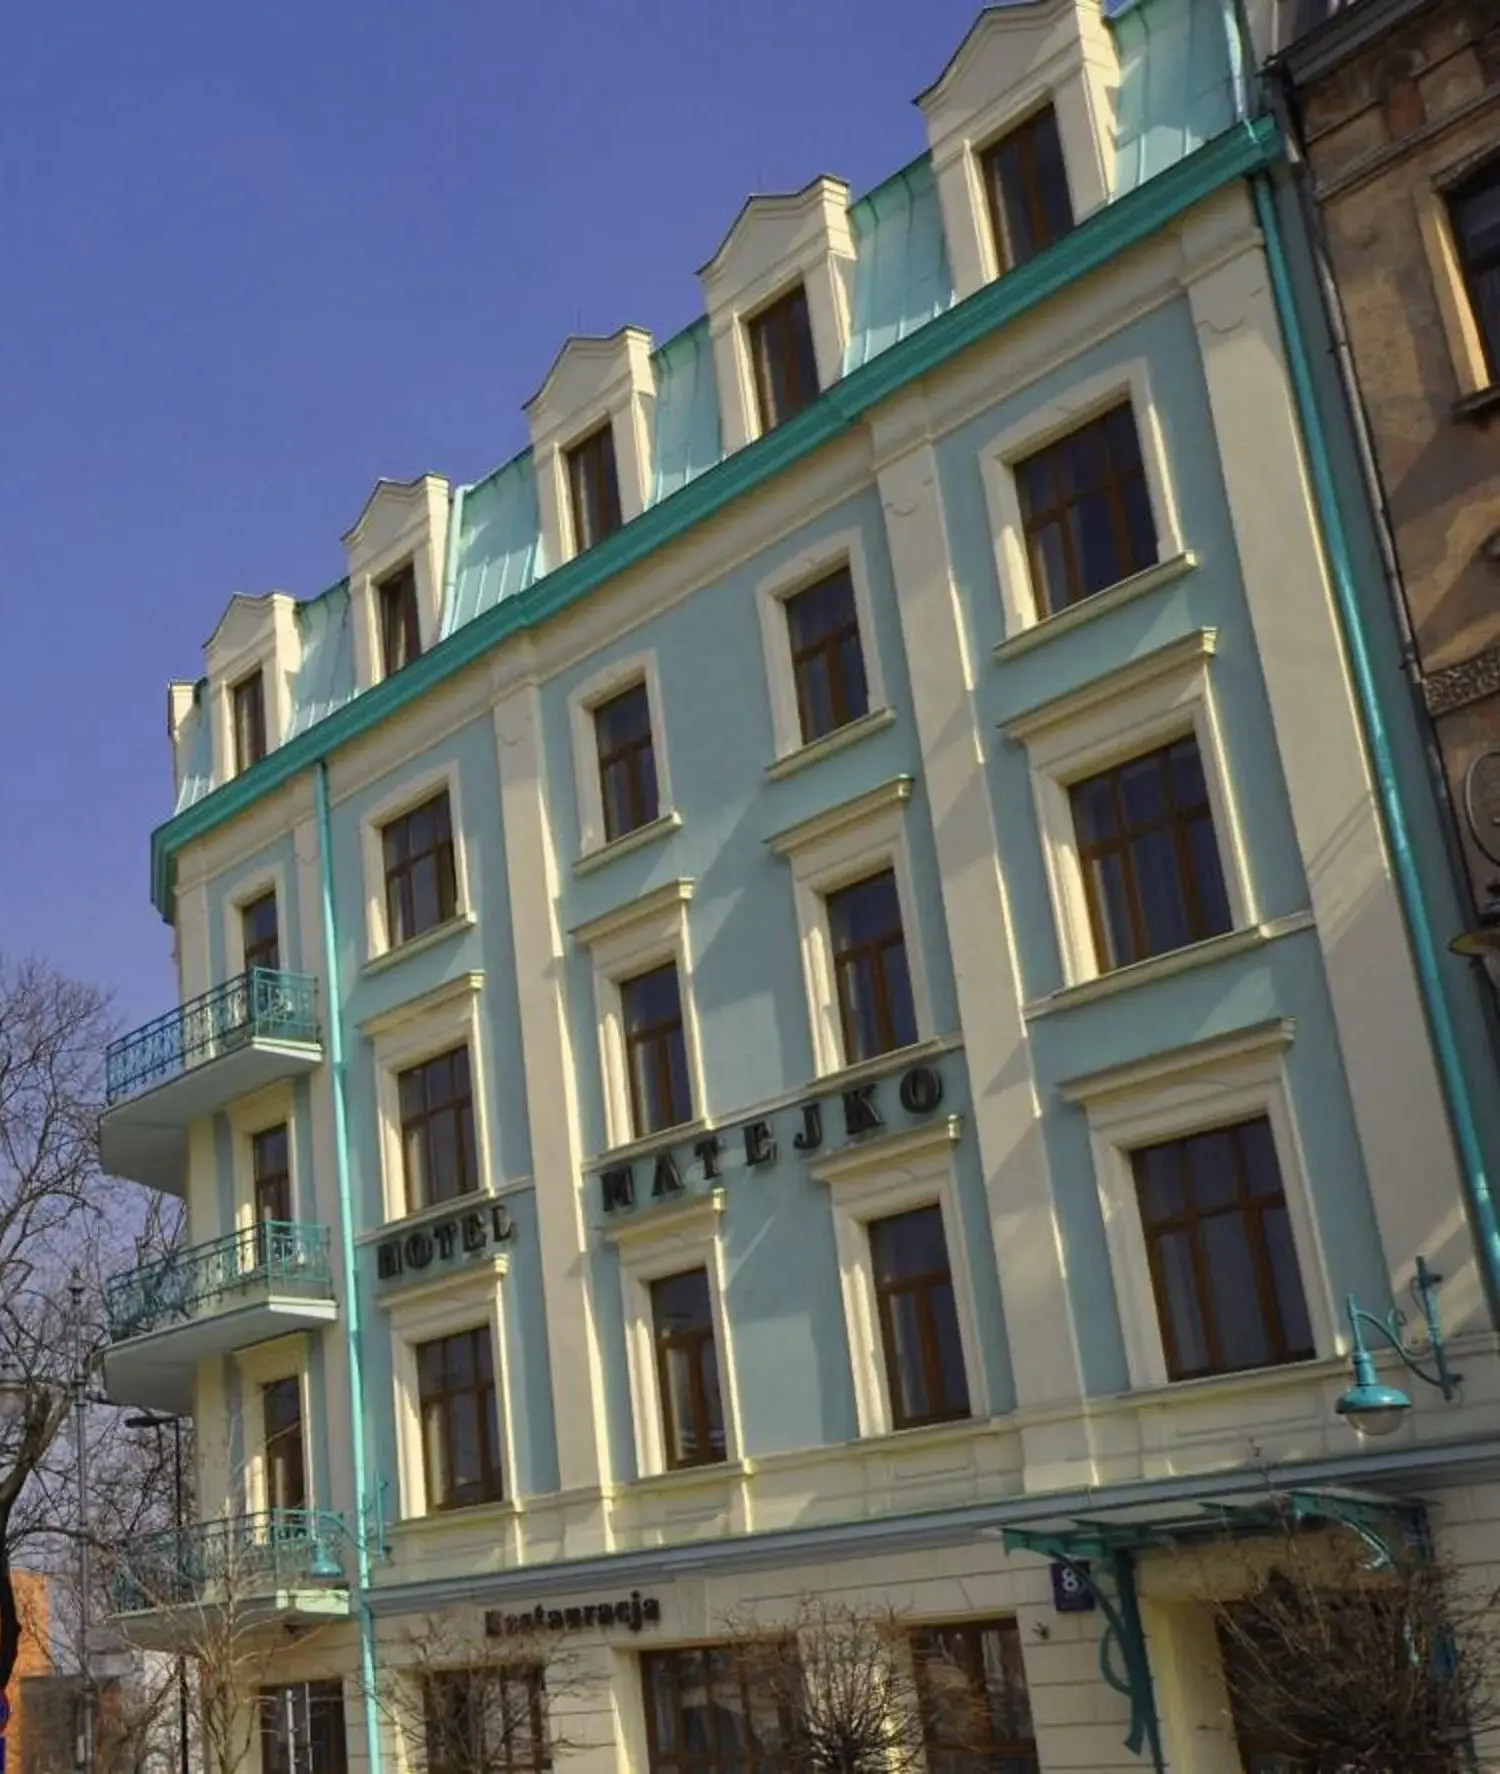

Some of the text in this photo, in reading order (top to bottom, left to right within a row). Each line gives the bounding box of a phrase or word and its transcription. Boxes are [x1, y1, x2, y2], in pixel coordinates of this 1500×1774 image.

[378, 1067, 943, 1279] HOTEL MATEJKO
[1062, 1568, 1078, 1592] 8
[484, 1590, 660, 1637] Restauracja
